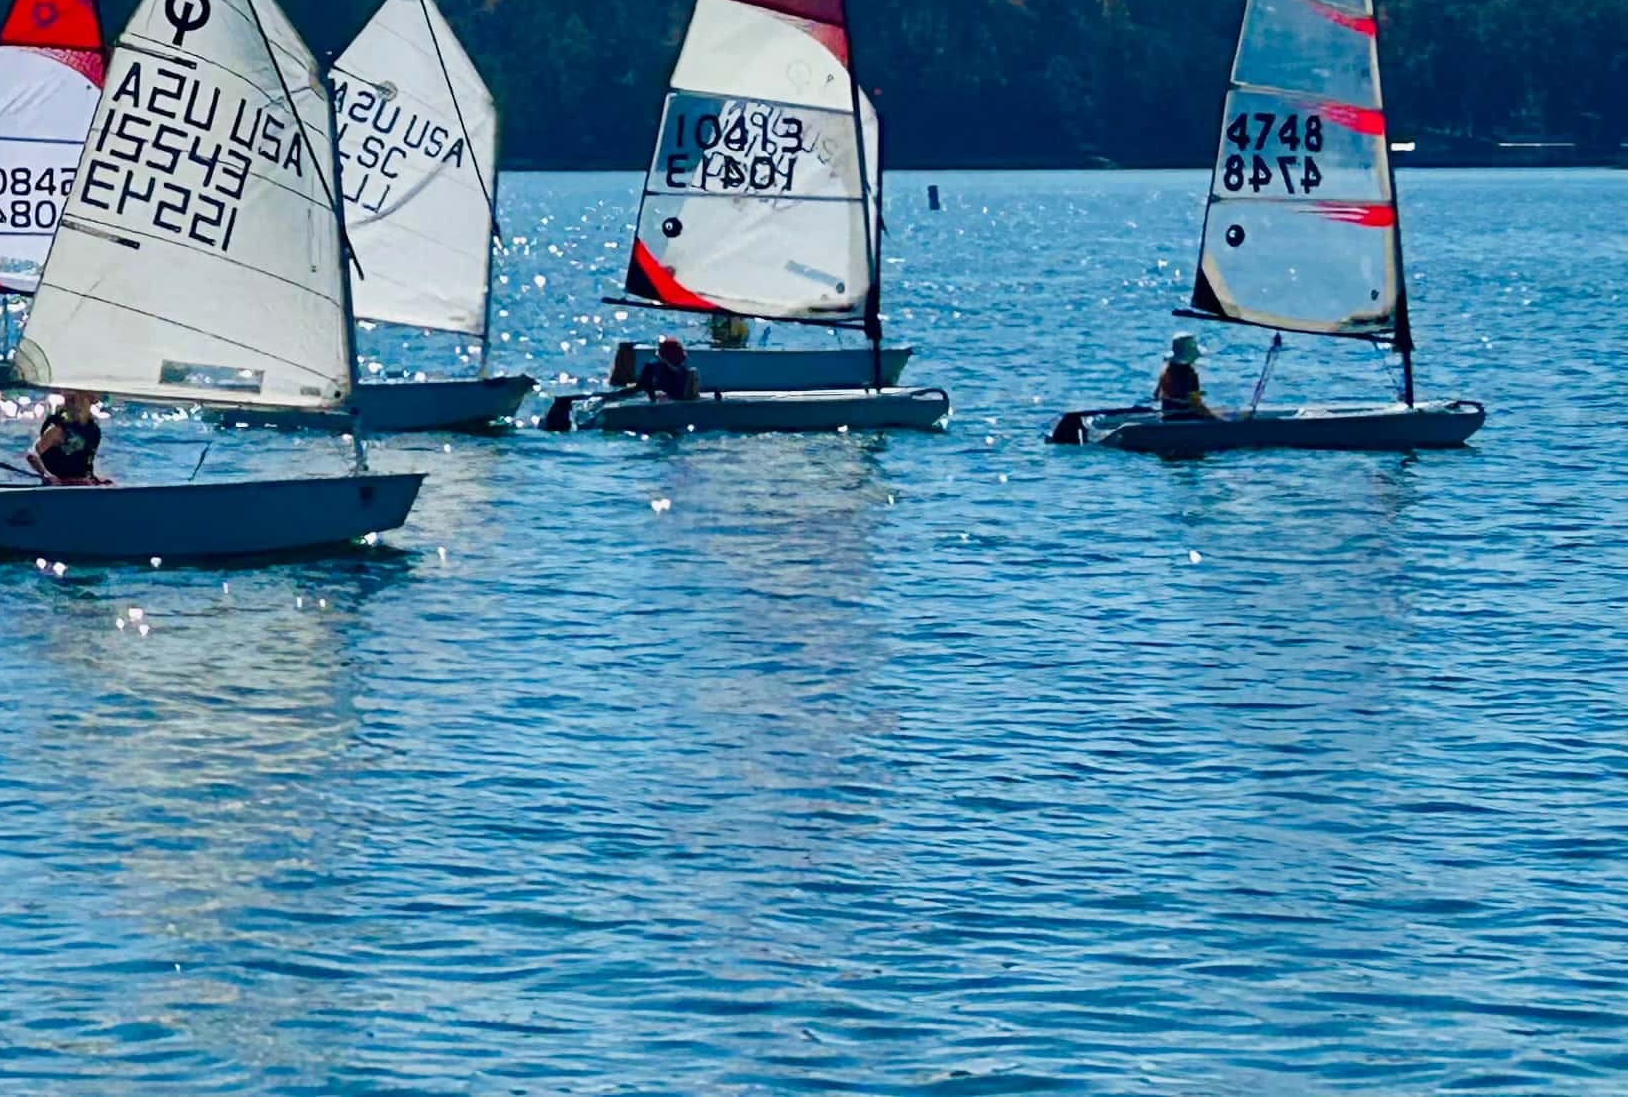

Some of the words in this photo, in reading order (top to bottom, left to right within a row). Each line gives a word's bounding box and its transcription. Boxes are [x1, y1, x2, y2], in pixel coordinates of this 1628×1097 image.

[95, 108, 252, 200] 15543
[229, 98, 303, 178] USA
[403, 114, 464, 168] USA
[1226, 112, 1324, 153] 4748
